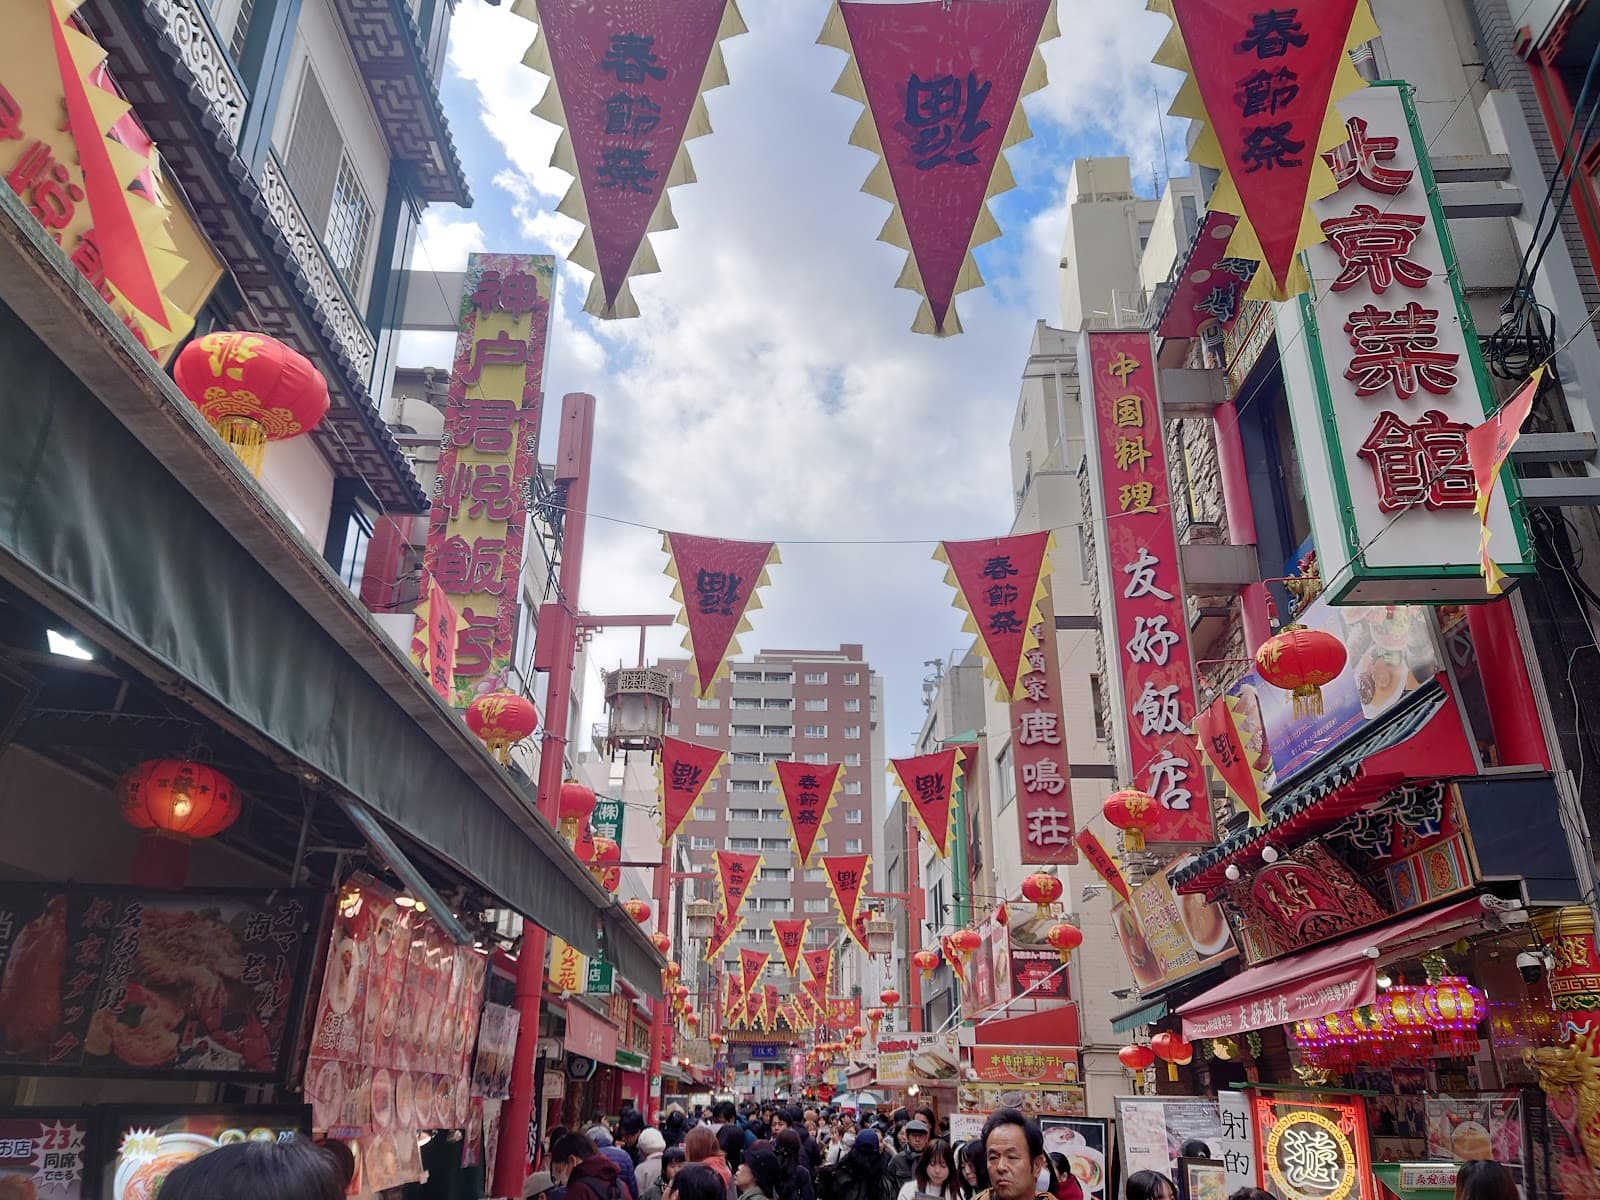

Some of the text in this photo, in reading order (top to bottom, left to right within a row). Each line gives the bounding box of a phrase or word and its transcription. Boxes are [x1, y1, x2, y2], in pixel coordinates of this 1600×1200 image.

[600, 32, 667, 194] 春節祭
[1238, 8, 1309, 173] 春節祭
[1318, 117, 1482, 514] 北京菜館
[1108, 352, 1158, 515] 中国料理
[983, 555, 1023, 635] 春節祭
[1123, 547, 1193, 811] 友好飯店
[797, 774, 820, 825] 春節祭
[1019, 708, 1071, 847] 鹿鳴荘
[1239, 994, 1290, 1030] 友好飯店
[991, 1055, 1064, 1068] 本格中華ポテト
[42, 1127, 81, 1150] 23人
[43, 1152, 76, 1169] 同席
[1221, 1109, 1250, 1176] 射的
[43, 1170, 74, 1182] できる
